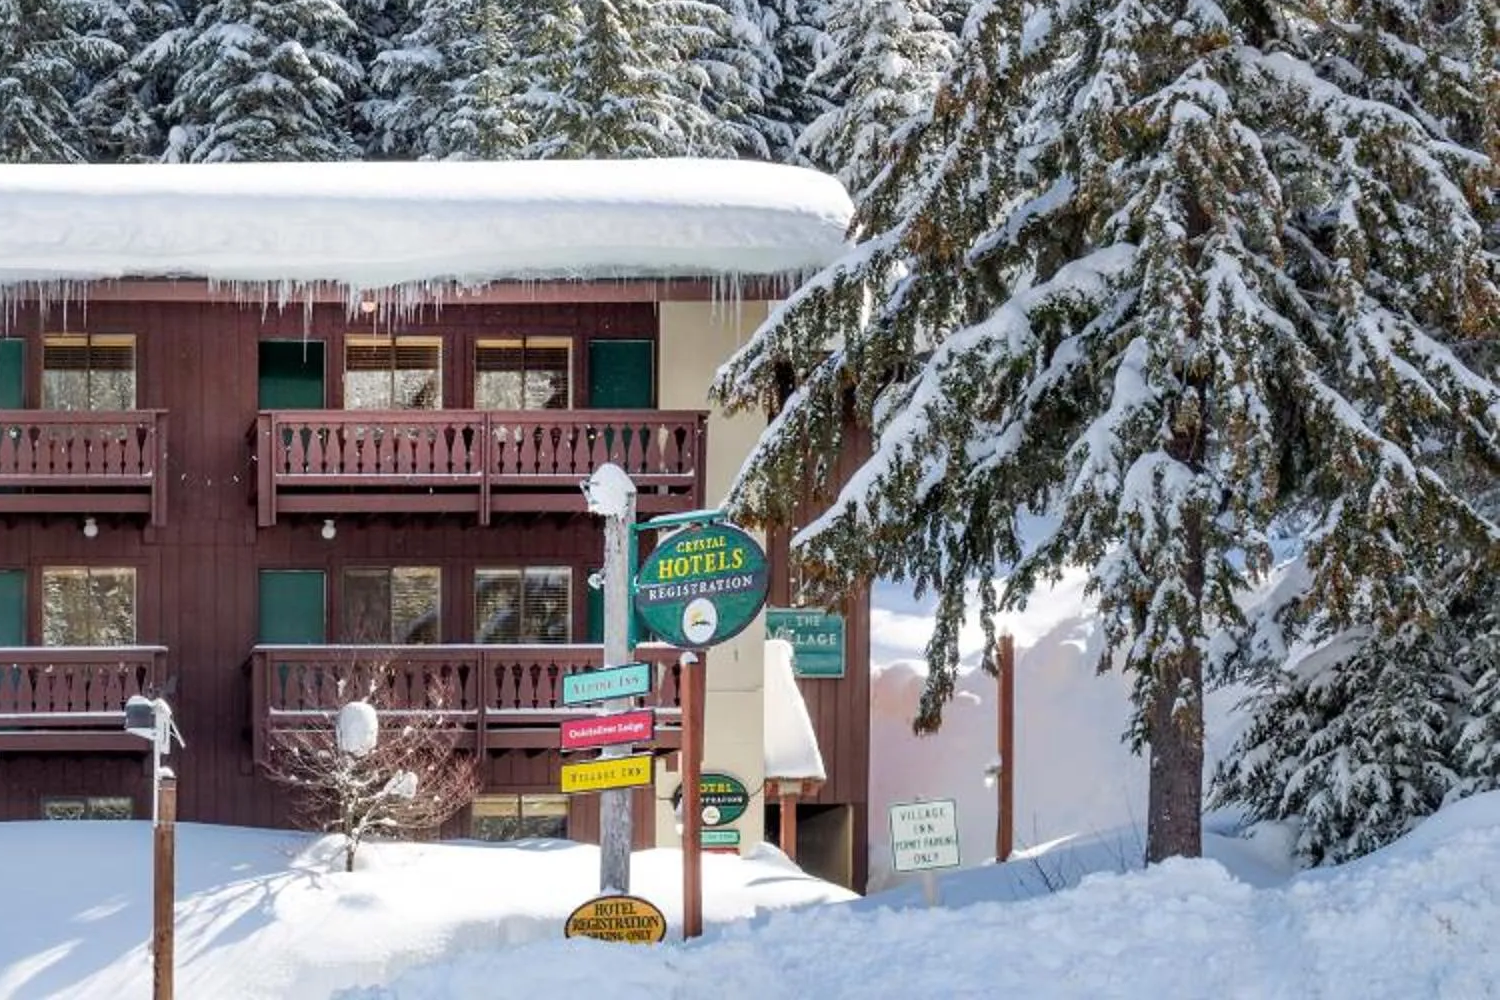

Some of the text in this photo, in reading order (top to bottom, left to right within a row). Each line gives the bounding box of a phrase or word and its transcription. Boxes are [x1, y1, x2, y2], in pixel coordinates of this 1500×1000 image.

[676, 535, 726, 553] CRYSTAL
[658, 548, 744, 579] HOTELS
[648, 574, 753, 601] REGISTRATION
[796, 615, 820, 627] THE
[700, 783, 733, 794] OTEL
[900, 807, 945, 821] VILLAGE
[913, 823, 935, 835] INN
[913, 852, 939, 865] ONLY
[595, 903, 637, 916] HOTEL
[572, 916, 659, 931] REGISTRATION
